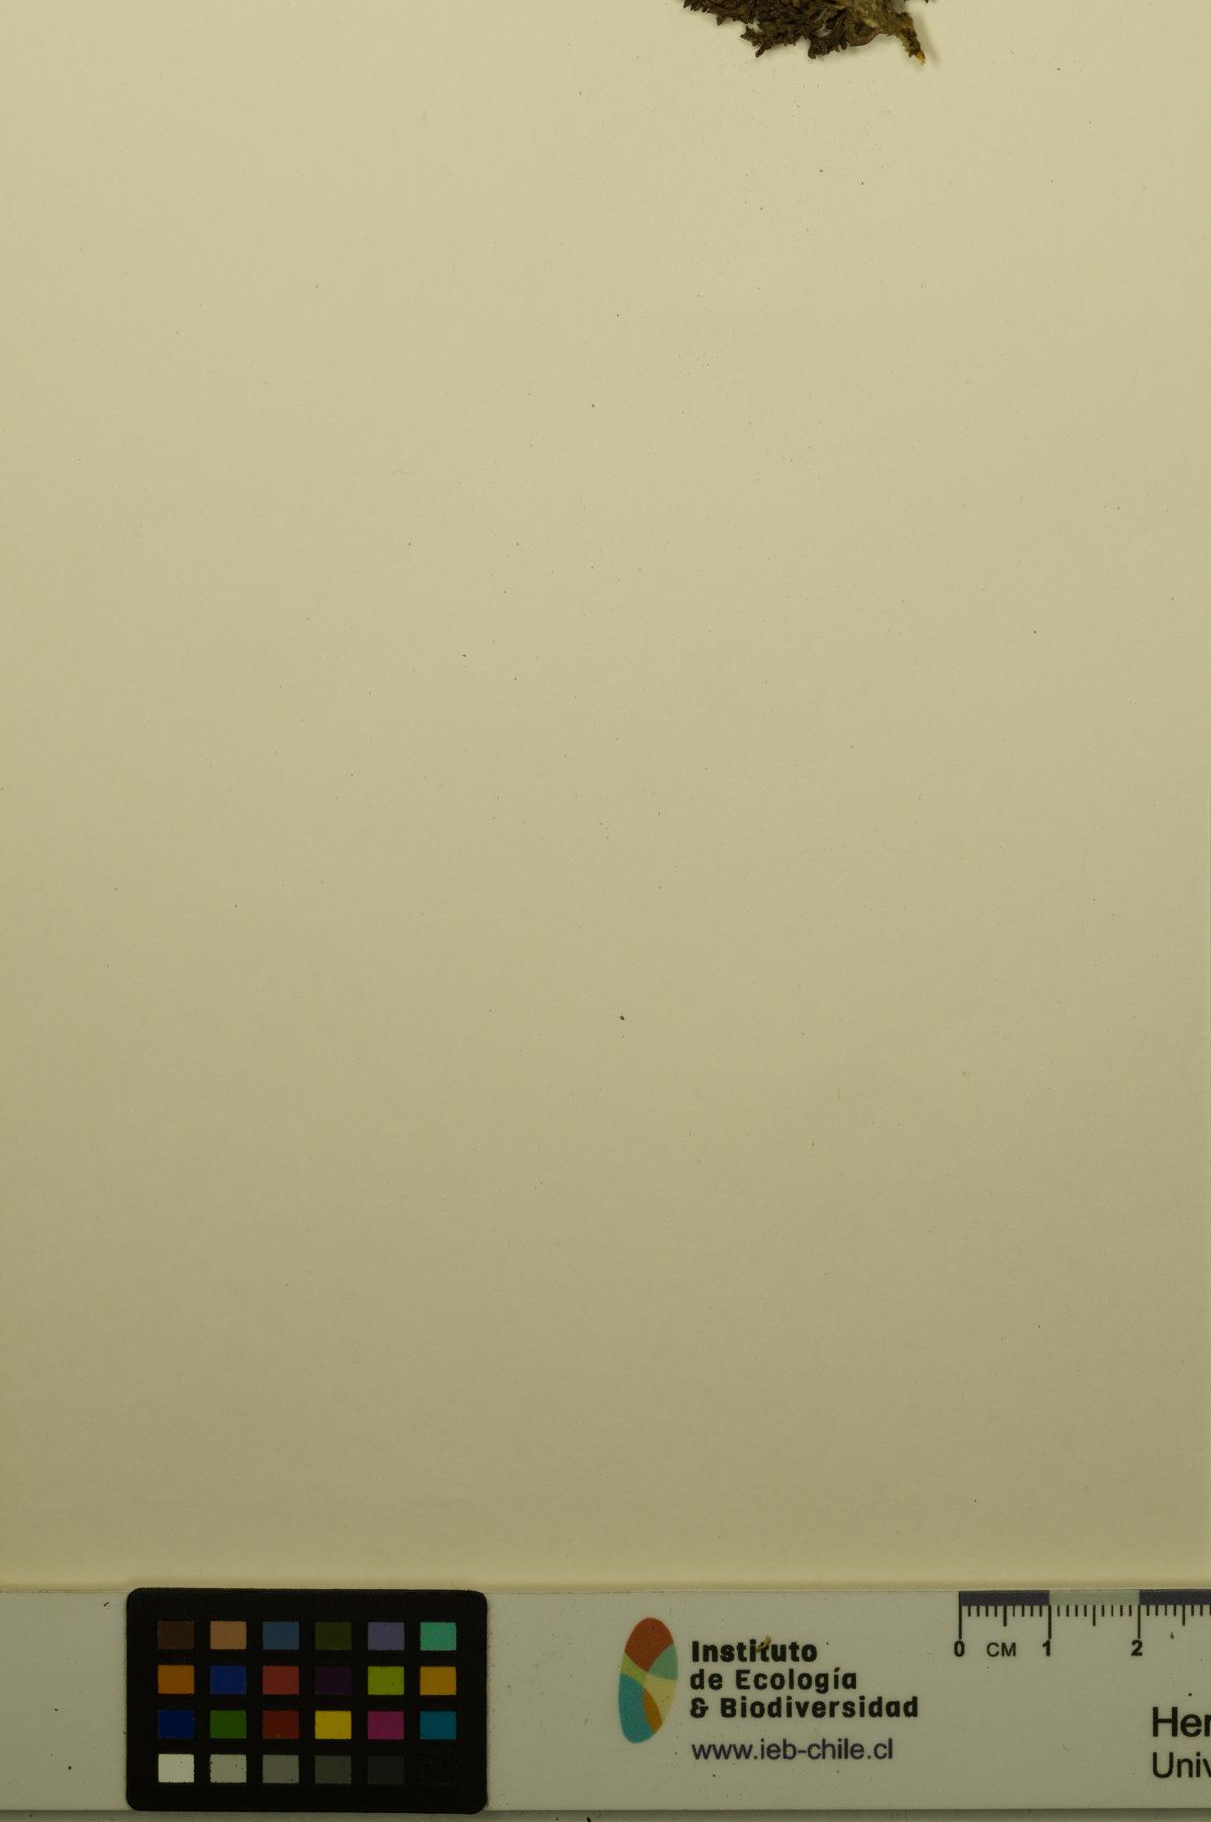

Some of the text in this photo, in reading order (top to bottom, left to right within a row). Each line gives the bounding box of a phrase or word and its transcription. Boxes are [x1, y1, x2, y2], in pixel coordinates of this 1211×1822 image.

[691, 1638, 818, 1663] Instituto
[953, 1639, 966, 1658] 0
[986, 1641, 1017, 1658] CM
[1041, 1638, 1051, 1657] 1
[1130, 1638, 1143, 1657] 2
[689, 1666, 859, 1695] de Ecología
[689, 1695, 919, 1719] & Biodiversidad
[690, 1737, 894, 1761] www.ieb-chile.cl
